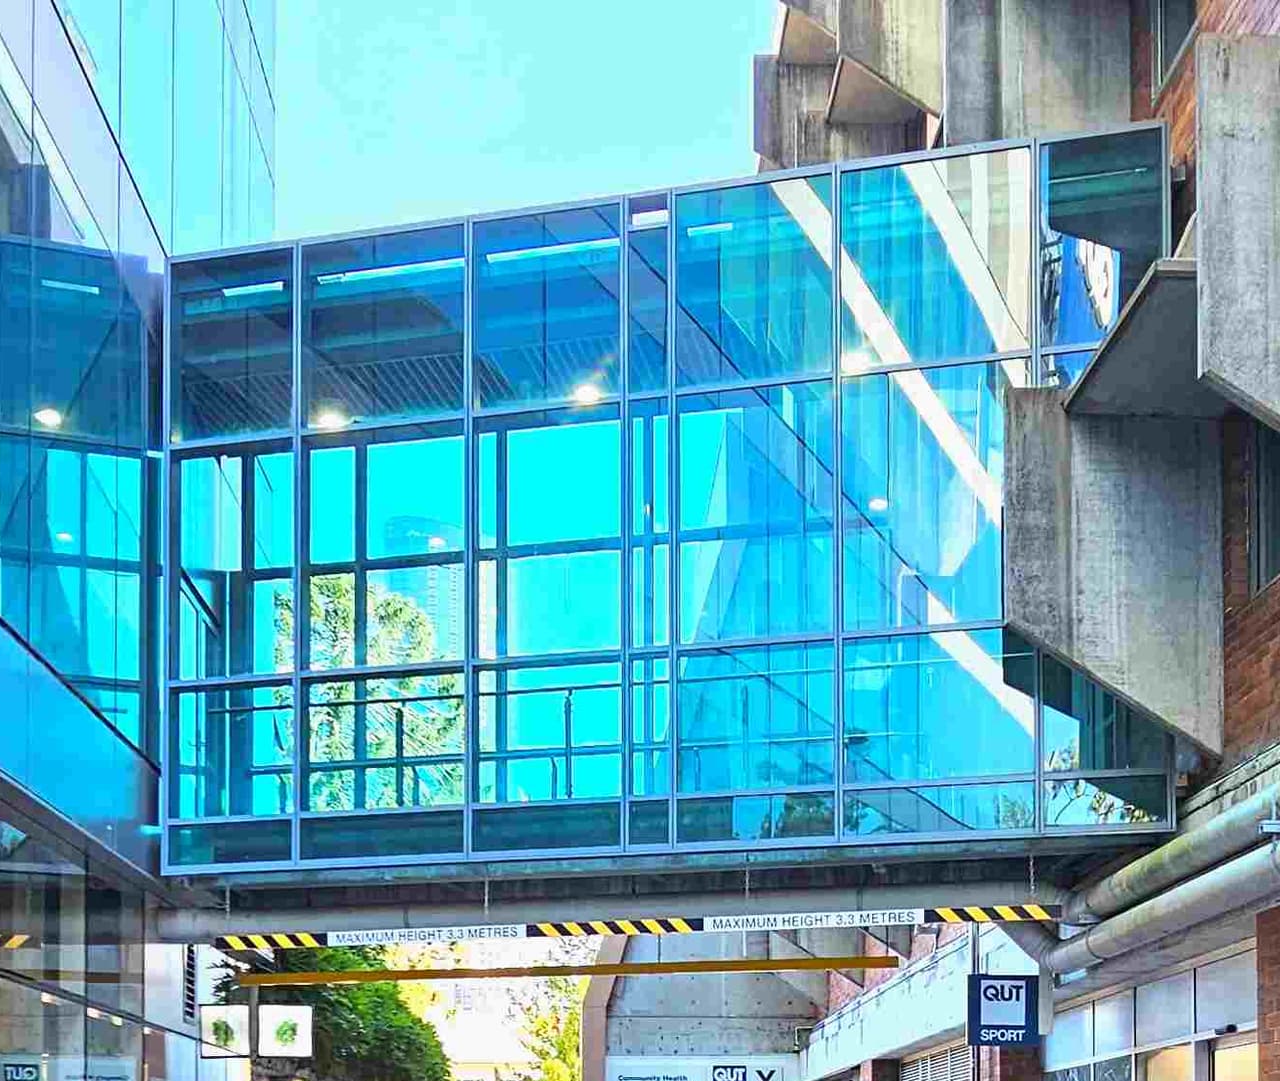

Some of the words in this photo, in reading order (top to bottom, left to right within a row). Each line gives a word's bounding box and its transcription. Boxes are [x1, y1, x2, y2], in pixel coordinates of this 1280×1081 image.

[712, 916, 778, 930] MAXIMUM
[782, 914, 831, 927] HEIGHT
[835, 913, 855, 926] 3.3
[859, 911, 916, 924] METRES
[335, 931, 394, 944] MAXIMUM
[398, 929, 443, 941] HEIGHT
[447, 928, 464, 940] 3.3
[468, 926, 519, 938] METRES
[982, 984, 1023, 1002] QUT
[980, 1029, 1026, 1041] SPORT
[662, 1074, 688, 1081] Health
